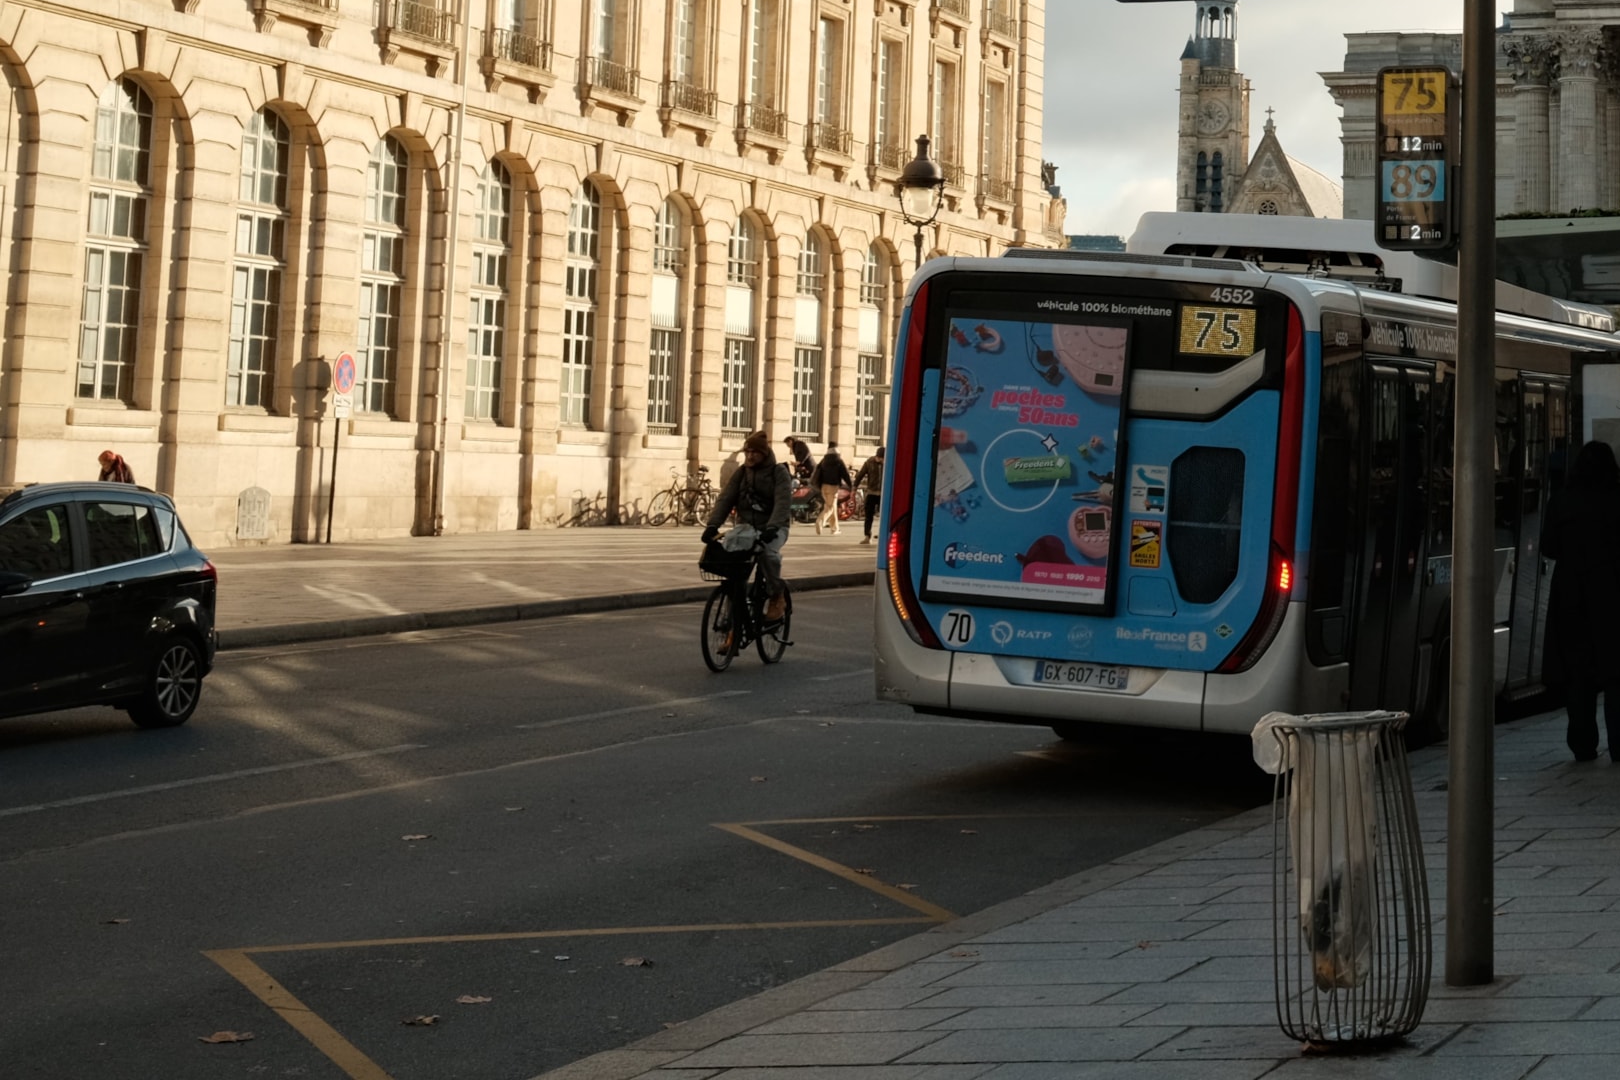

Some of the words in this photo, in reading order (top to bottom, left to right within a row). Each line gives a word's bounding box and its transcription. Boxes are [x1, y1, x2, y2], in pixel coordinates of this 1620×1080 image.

[1391, 78, 1437, 111] 75
[1391, 165, 1437, 198] 89
[1210, 287, 1254, 306] 4552
[1037, 300, 1080, 313] véhicule
[1081, 302, 1110, 314] 100%
[1111, 303, 1172, 317] biométhane
[1195, 311, 1241, 350] 75
[1371, 322, 1404, 348] véhicule
[1404, 325, 1426, 350] 100%
[1426, 328, 1457, 354] biométh
[991, 388, 1065, 409] poches
[1014, 460, 1055, 470] Freedent
[944, 546, 1004, 564] Freedent
[1066, 572, 1085, 581] 1990
[947, 613, 970, 643] 70
[1016, 629, 1053, 640] RATP
